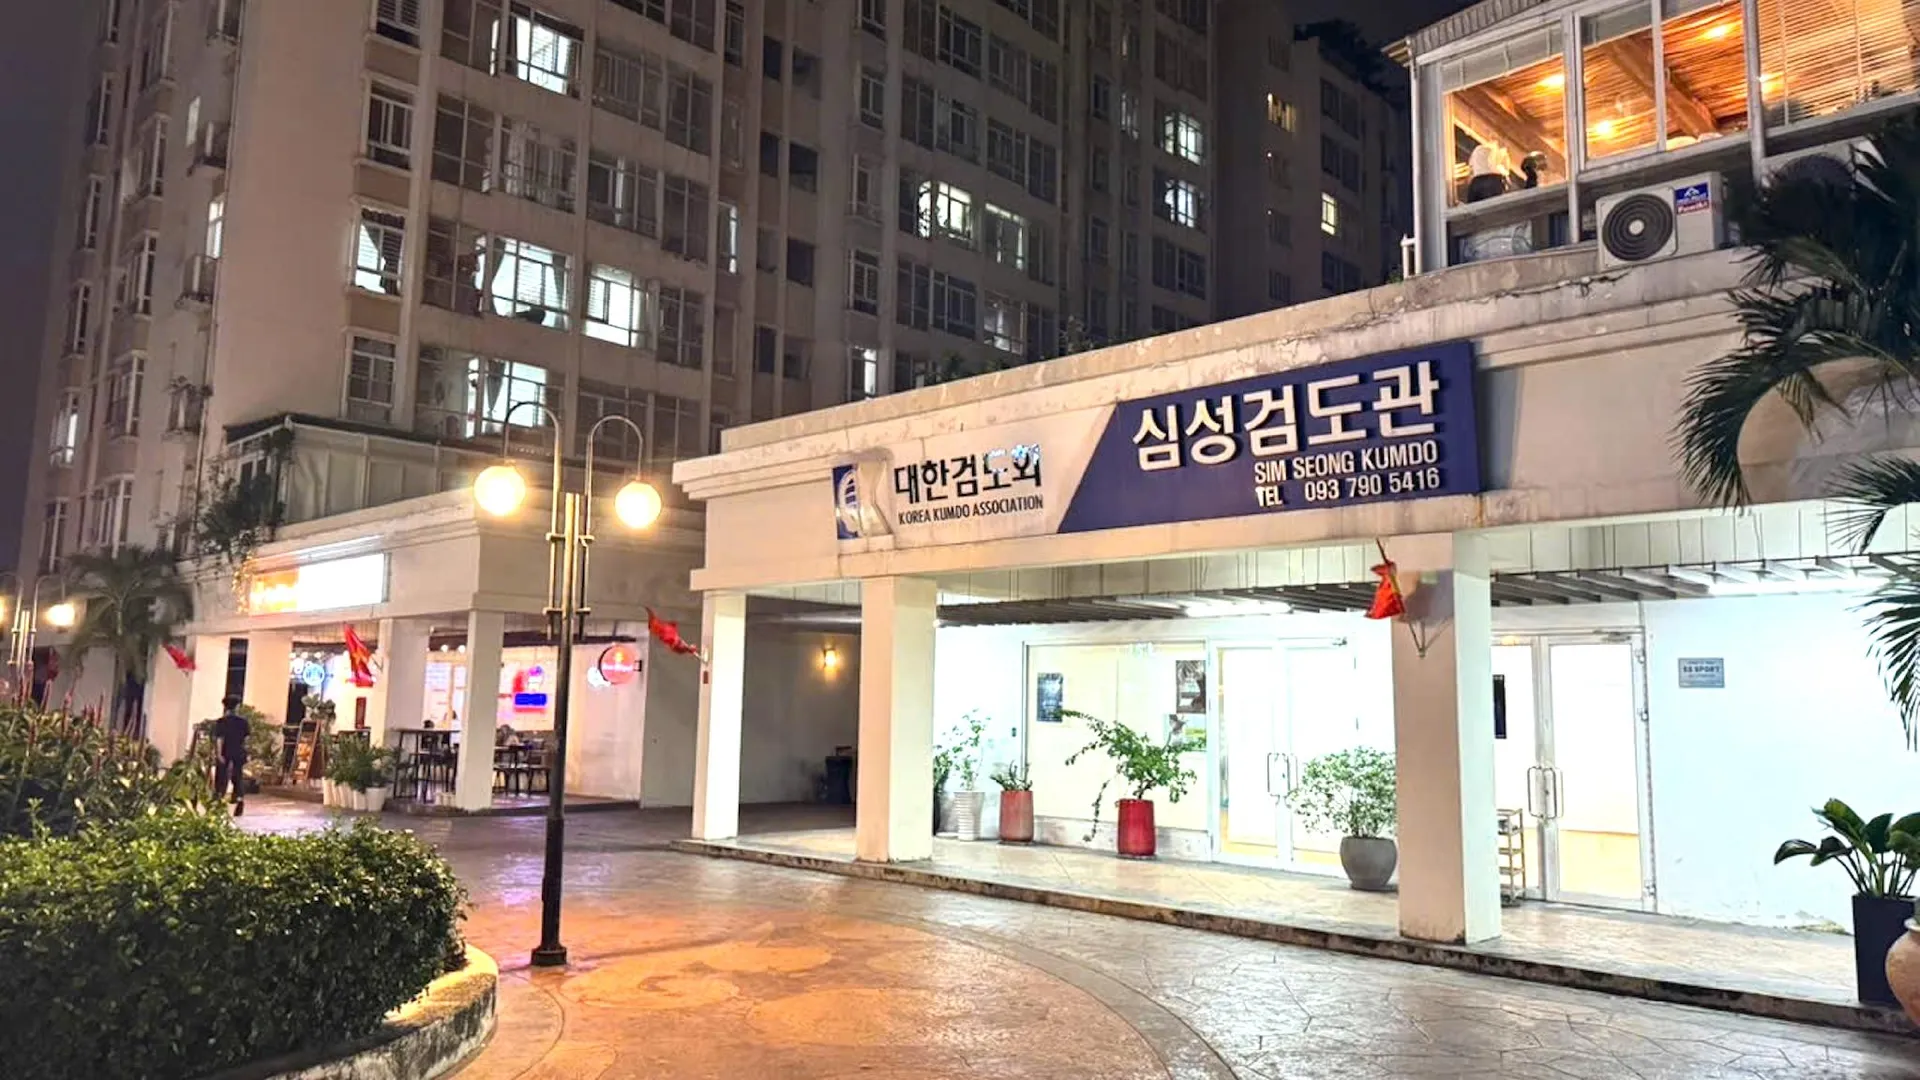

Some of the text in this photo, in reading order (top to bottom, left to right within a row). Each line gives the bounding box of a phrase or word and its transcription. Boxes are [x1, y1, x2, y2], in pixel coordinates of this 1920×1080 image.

[1132, 361, 1440, 471] 심성검도관
[1254, 440, 1438, 484] SIM SEONG KUMDO
[1255, 467, 1440, 507] TEL 093 790 5416
[898, 494, 1044, 526] KOREA KUMDO ASSOCIATION
